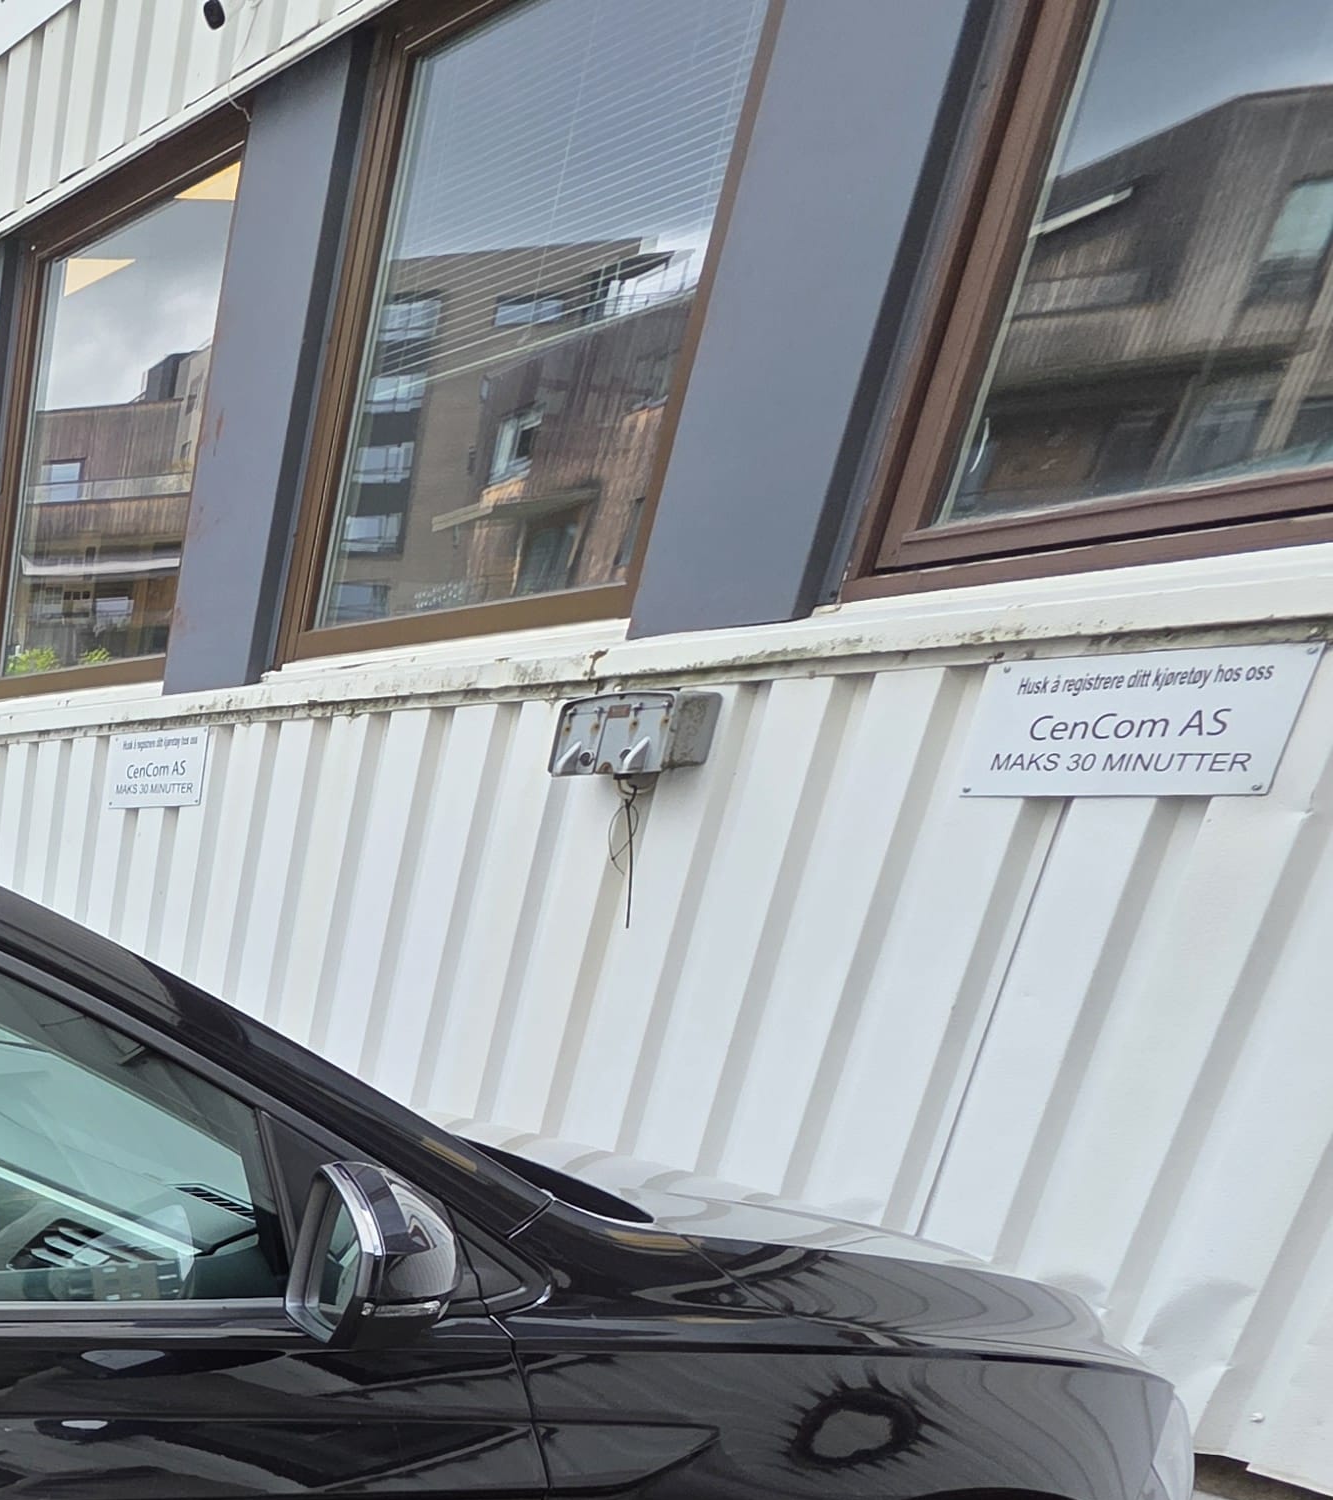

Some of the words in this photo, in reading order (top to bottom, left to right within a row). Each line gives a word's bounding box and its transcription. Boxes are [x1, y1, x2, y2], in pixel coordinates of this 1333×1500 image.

[1017, 677, 1049, 695] Husk
[1050, 680, 1059, 694] å
[1061, 673, 1125, 697] registrere
[1126, 669, 1152, 690] ditt
[1151, 667, 1212, 692] kjøretøy
[1213, 664, 1243, 684] hos
[1245, 664, 1275, 681] oss
[1029, 713, 1170, 741] CenCom
[1178, 708, 1233, 737] AS
[126, 762, 170, 780] CenCom
[172, 760, 187, 776] AS
[989, 753, 1061, 772] MAKS
[1066, 753, 1097, 772] 30
[1101, 752, 1253, 773] MINUTTER
[139, 783, 149, 794] 30
